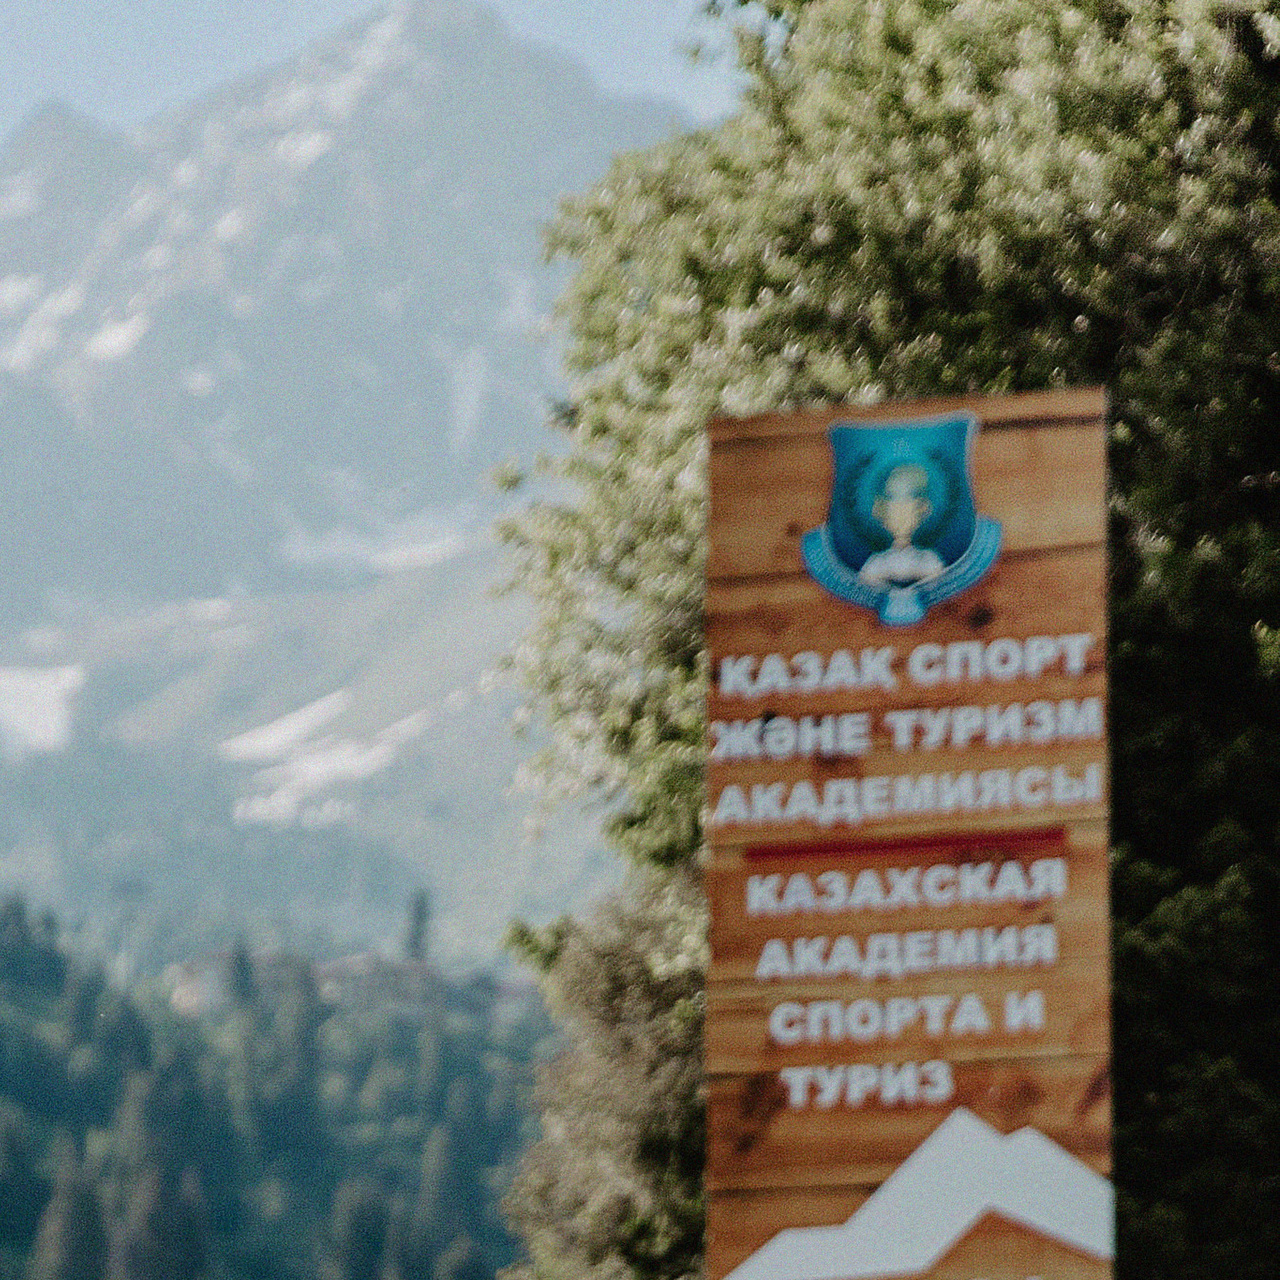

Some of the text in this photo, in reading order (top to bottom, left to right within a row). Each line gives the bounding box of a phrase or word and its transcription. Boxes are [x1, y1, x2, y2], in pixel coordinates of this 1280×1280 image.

[907, 633, 1095, 685] СПОРТ
[885, 697, 1104, 751] ТУРИЗМ
[710, 765, 1104, 825] АКАДЕМИЯСЫ
[746, 857, 1068, 916] КАЗАХСКАЯ
[755, 923, 1058, 980] АКАДЕМИЯ
[768, 989, 1046, 1045] СПОРТА И
[779, 1059, 956, 1109] ТУРИЗ
